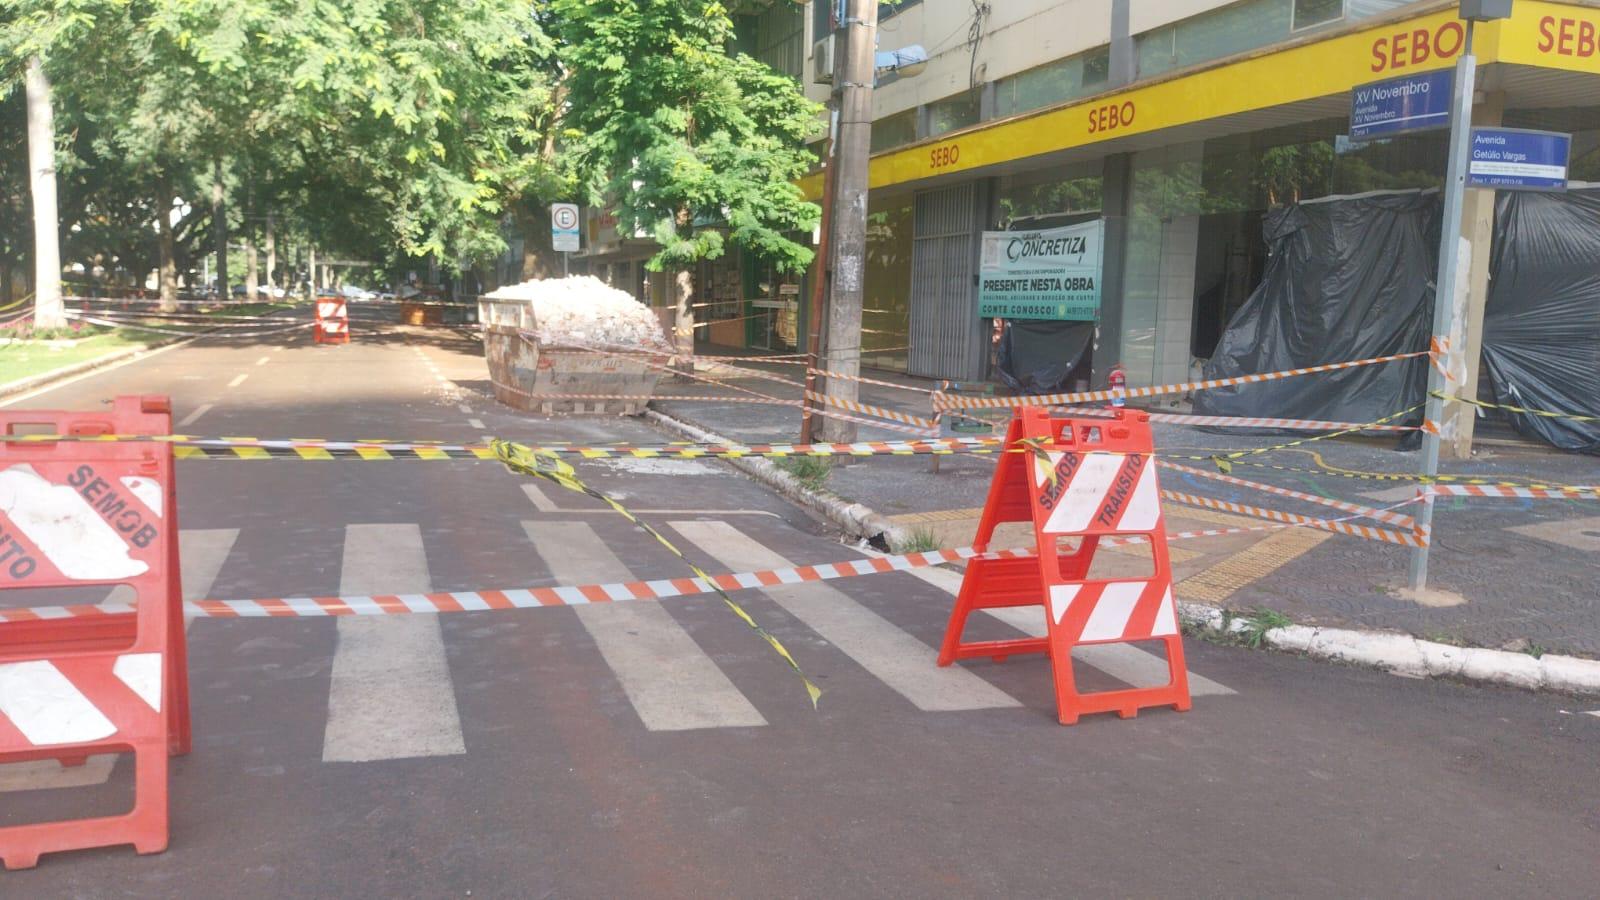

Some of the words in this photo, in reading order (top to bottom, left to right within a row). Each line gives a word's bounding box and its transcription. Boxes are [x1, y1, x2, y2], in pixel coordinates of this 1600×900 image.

[1538, 15, 1600, 58] SEB
[1371, 21, 1464, 73] SEBO
[1356, 89, 1370, 105] XV
[1372, 80, 1430, 101] Novembro
[1088, 101, 1136, 134] SEBO
[1364, 110, 1396, 121] Novembro
[1475, 135, 1506, 145] Avenida
[930, 144, 960, 169] SEBO
[1473, 149, 1501, 160] Getúlio
[1502, 151, 1527, 162] Vargas
[561, 211, 570, 225] E
[983, 279, 1028, 292] PRESENTE
[1030, 278, 1062, 291] NESTA
[1064, 277, 1094, 291] OBRA
[983, 305, 1008, 314] CONTE
[1011, 305, 1056, 315] CONOSCO!
[67, 464, 158, 549] SEMOB
